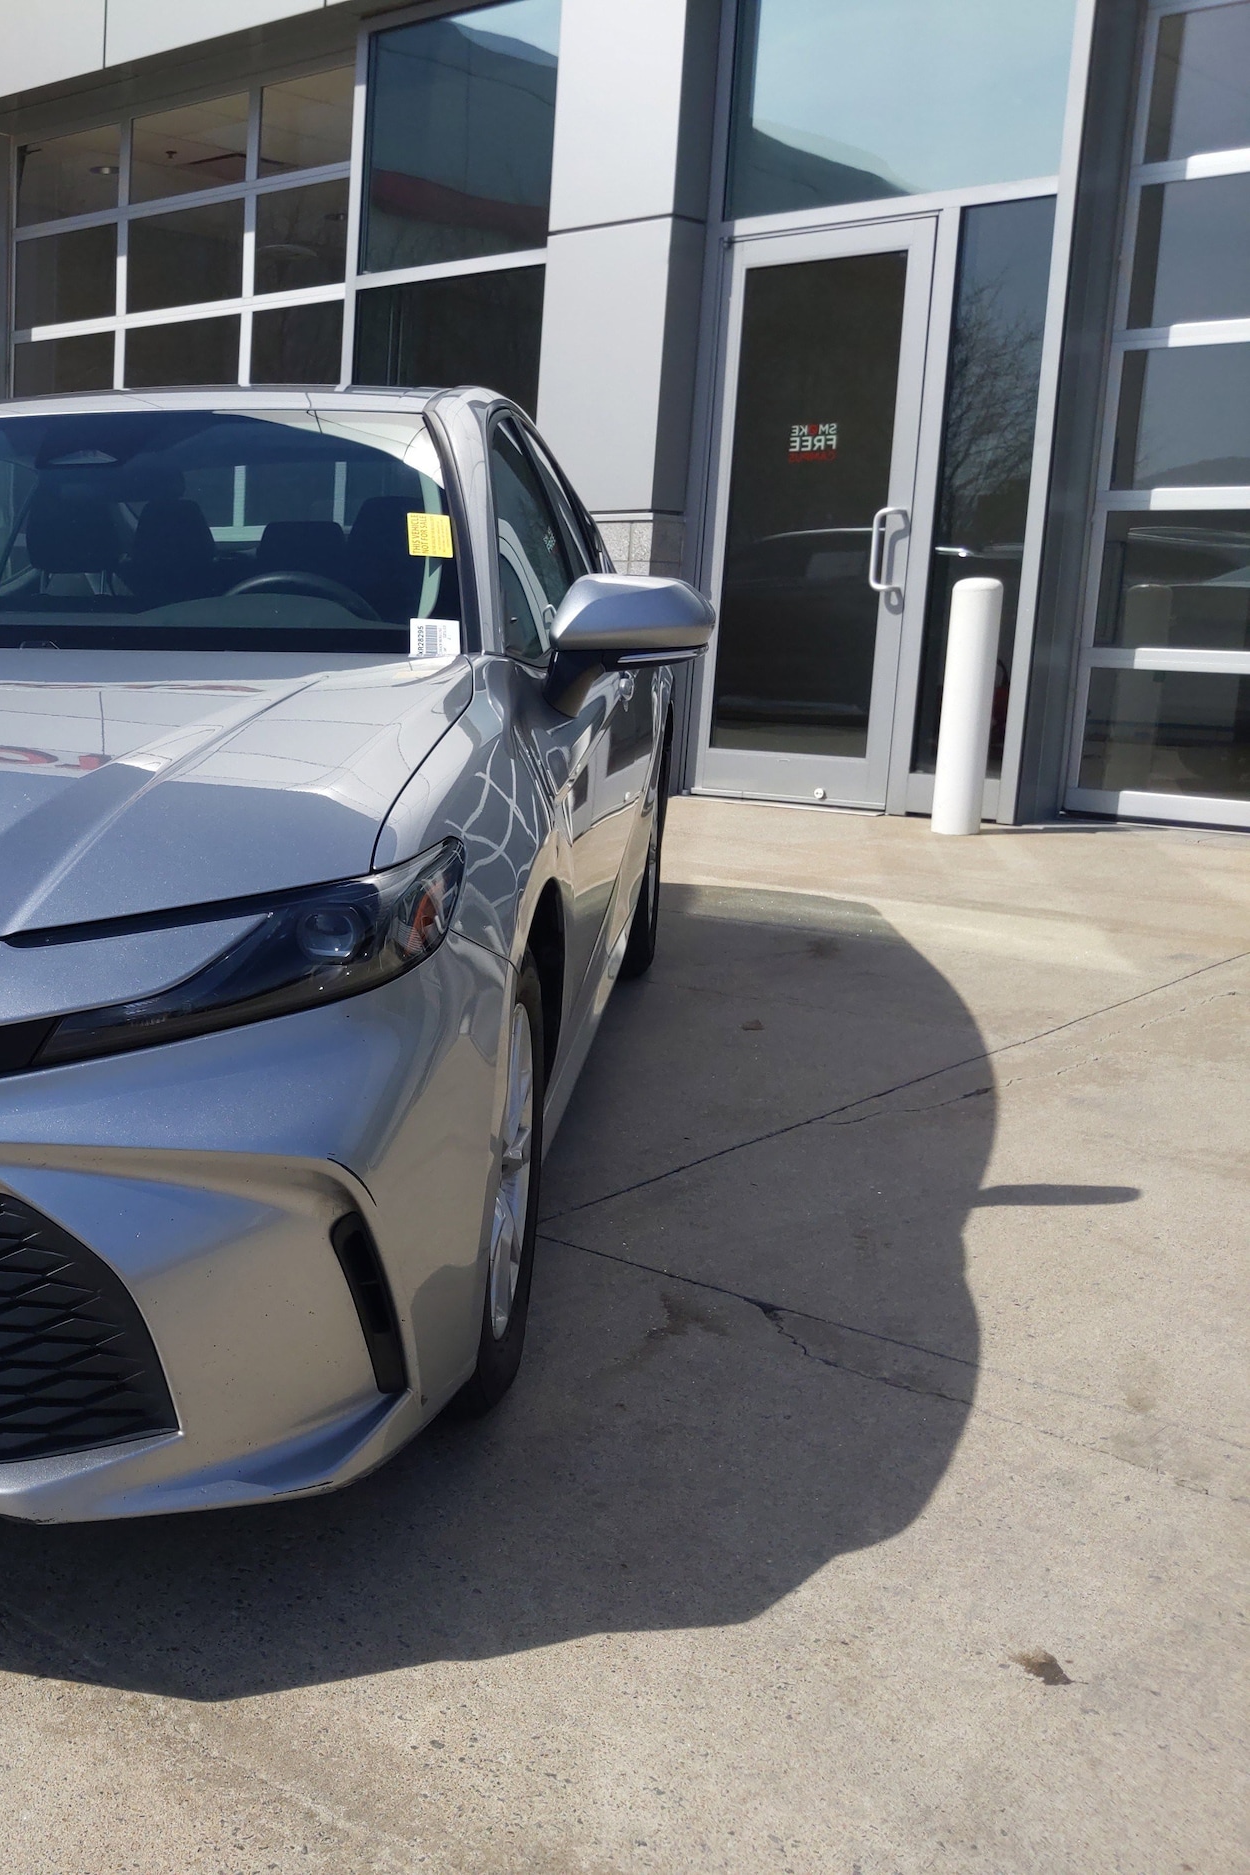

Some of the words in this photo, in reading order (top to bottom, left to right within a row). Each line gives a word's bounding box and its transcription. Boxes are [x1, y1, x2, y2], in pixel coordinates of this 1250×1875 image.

[410, 515, 419, 539] VEHICLE
[419, 516, 427, 528] SALE
[420, 530, 428, 541] FOR
[412, 540, 421, 554] THIS
[421, 542, 429, 554] NOT
